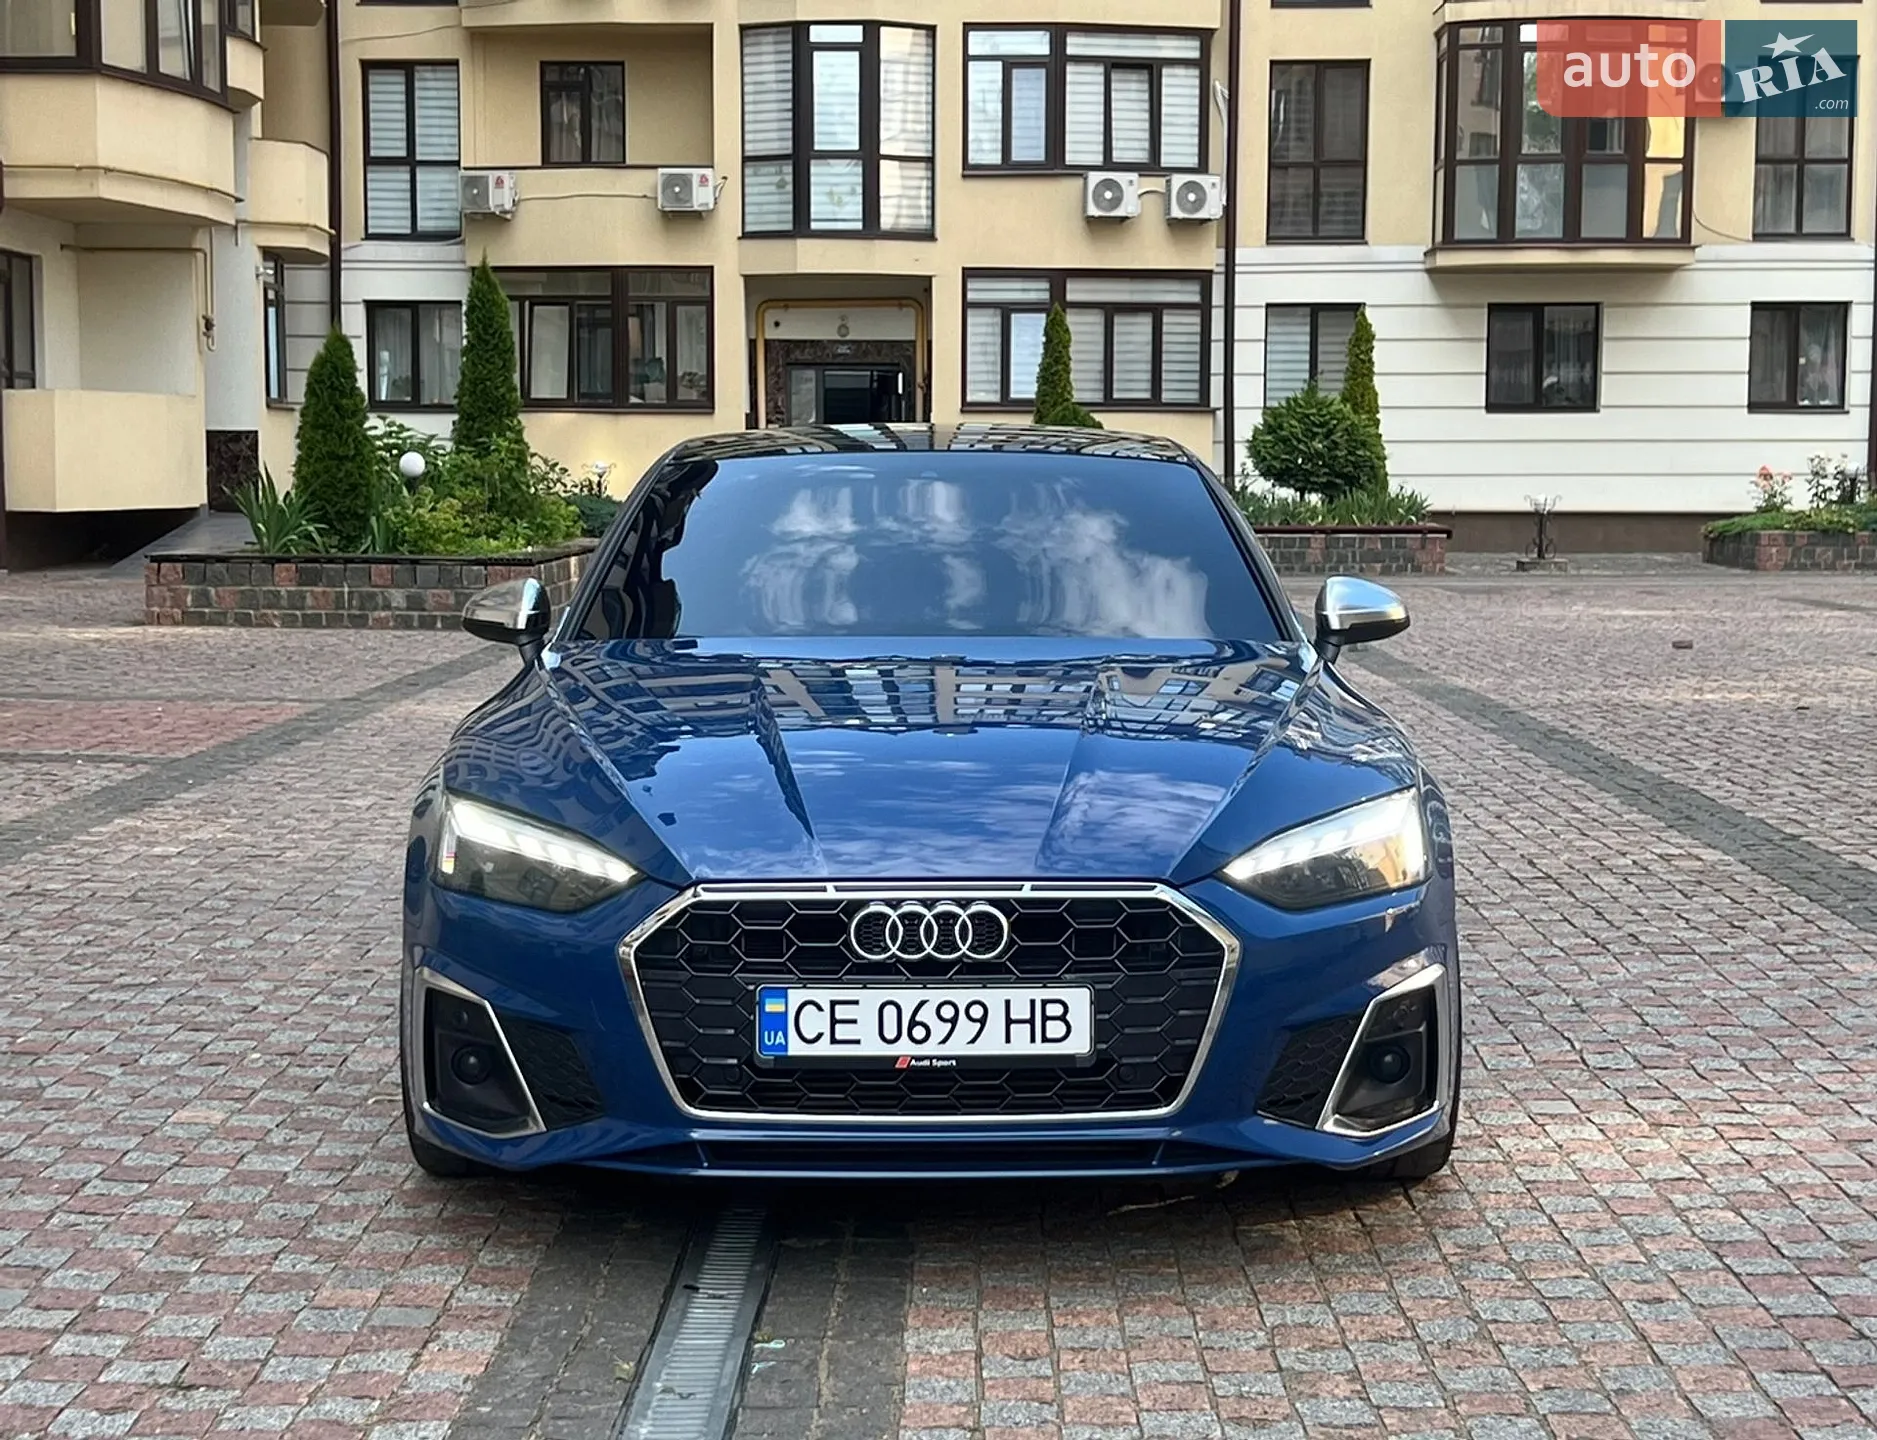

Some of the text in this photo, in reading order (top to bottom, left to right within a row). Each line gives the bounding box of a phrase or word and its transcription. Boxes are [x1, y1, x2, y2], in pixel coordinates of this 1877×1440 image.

[793, 998, 1072, 1045] CE 0699 HB
[764, 1031, 786, 1047] UA
[910, 1058, 957, 1068] Audi Sport
